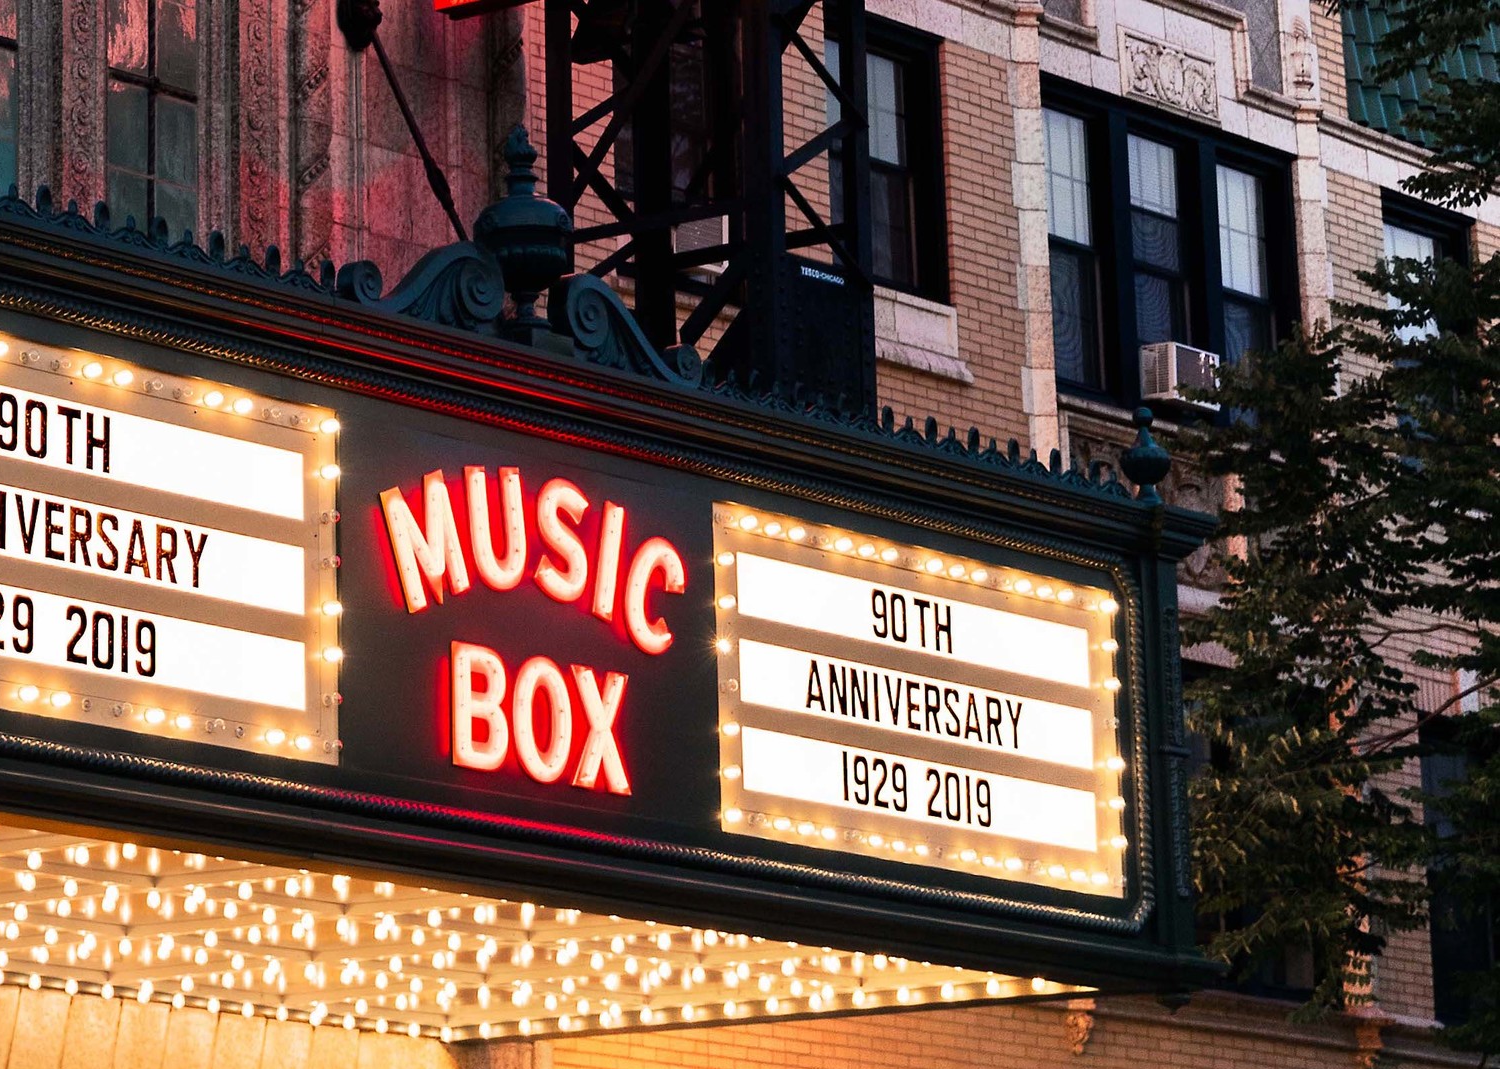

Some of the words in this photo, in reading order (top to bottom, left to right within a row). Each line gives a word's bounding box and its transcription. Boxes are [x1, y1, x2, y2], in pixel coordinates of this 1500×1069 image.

[380, 466, 687, 656] MUSIC
[65, 604, 157, 679] 2019
[871, 588, 954, 655] 90TH
[451, 640, 633, 796] BOX
[804, 658, 1025, 750] ANNIVERSARY
[841, 750, 909, 813] 1929
[925, 767, 993, 829] 2019
